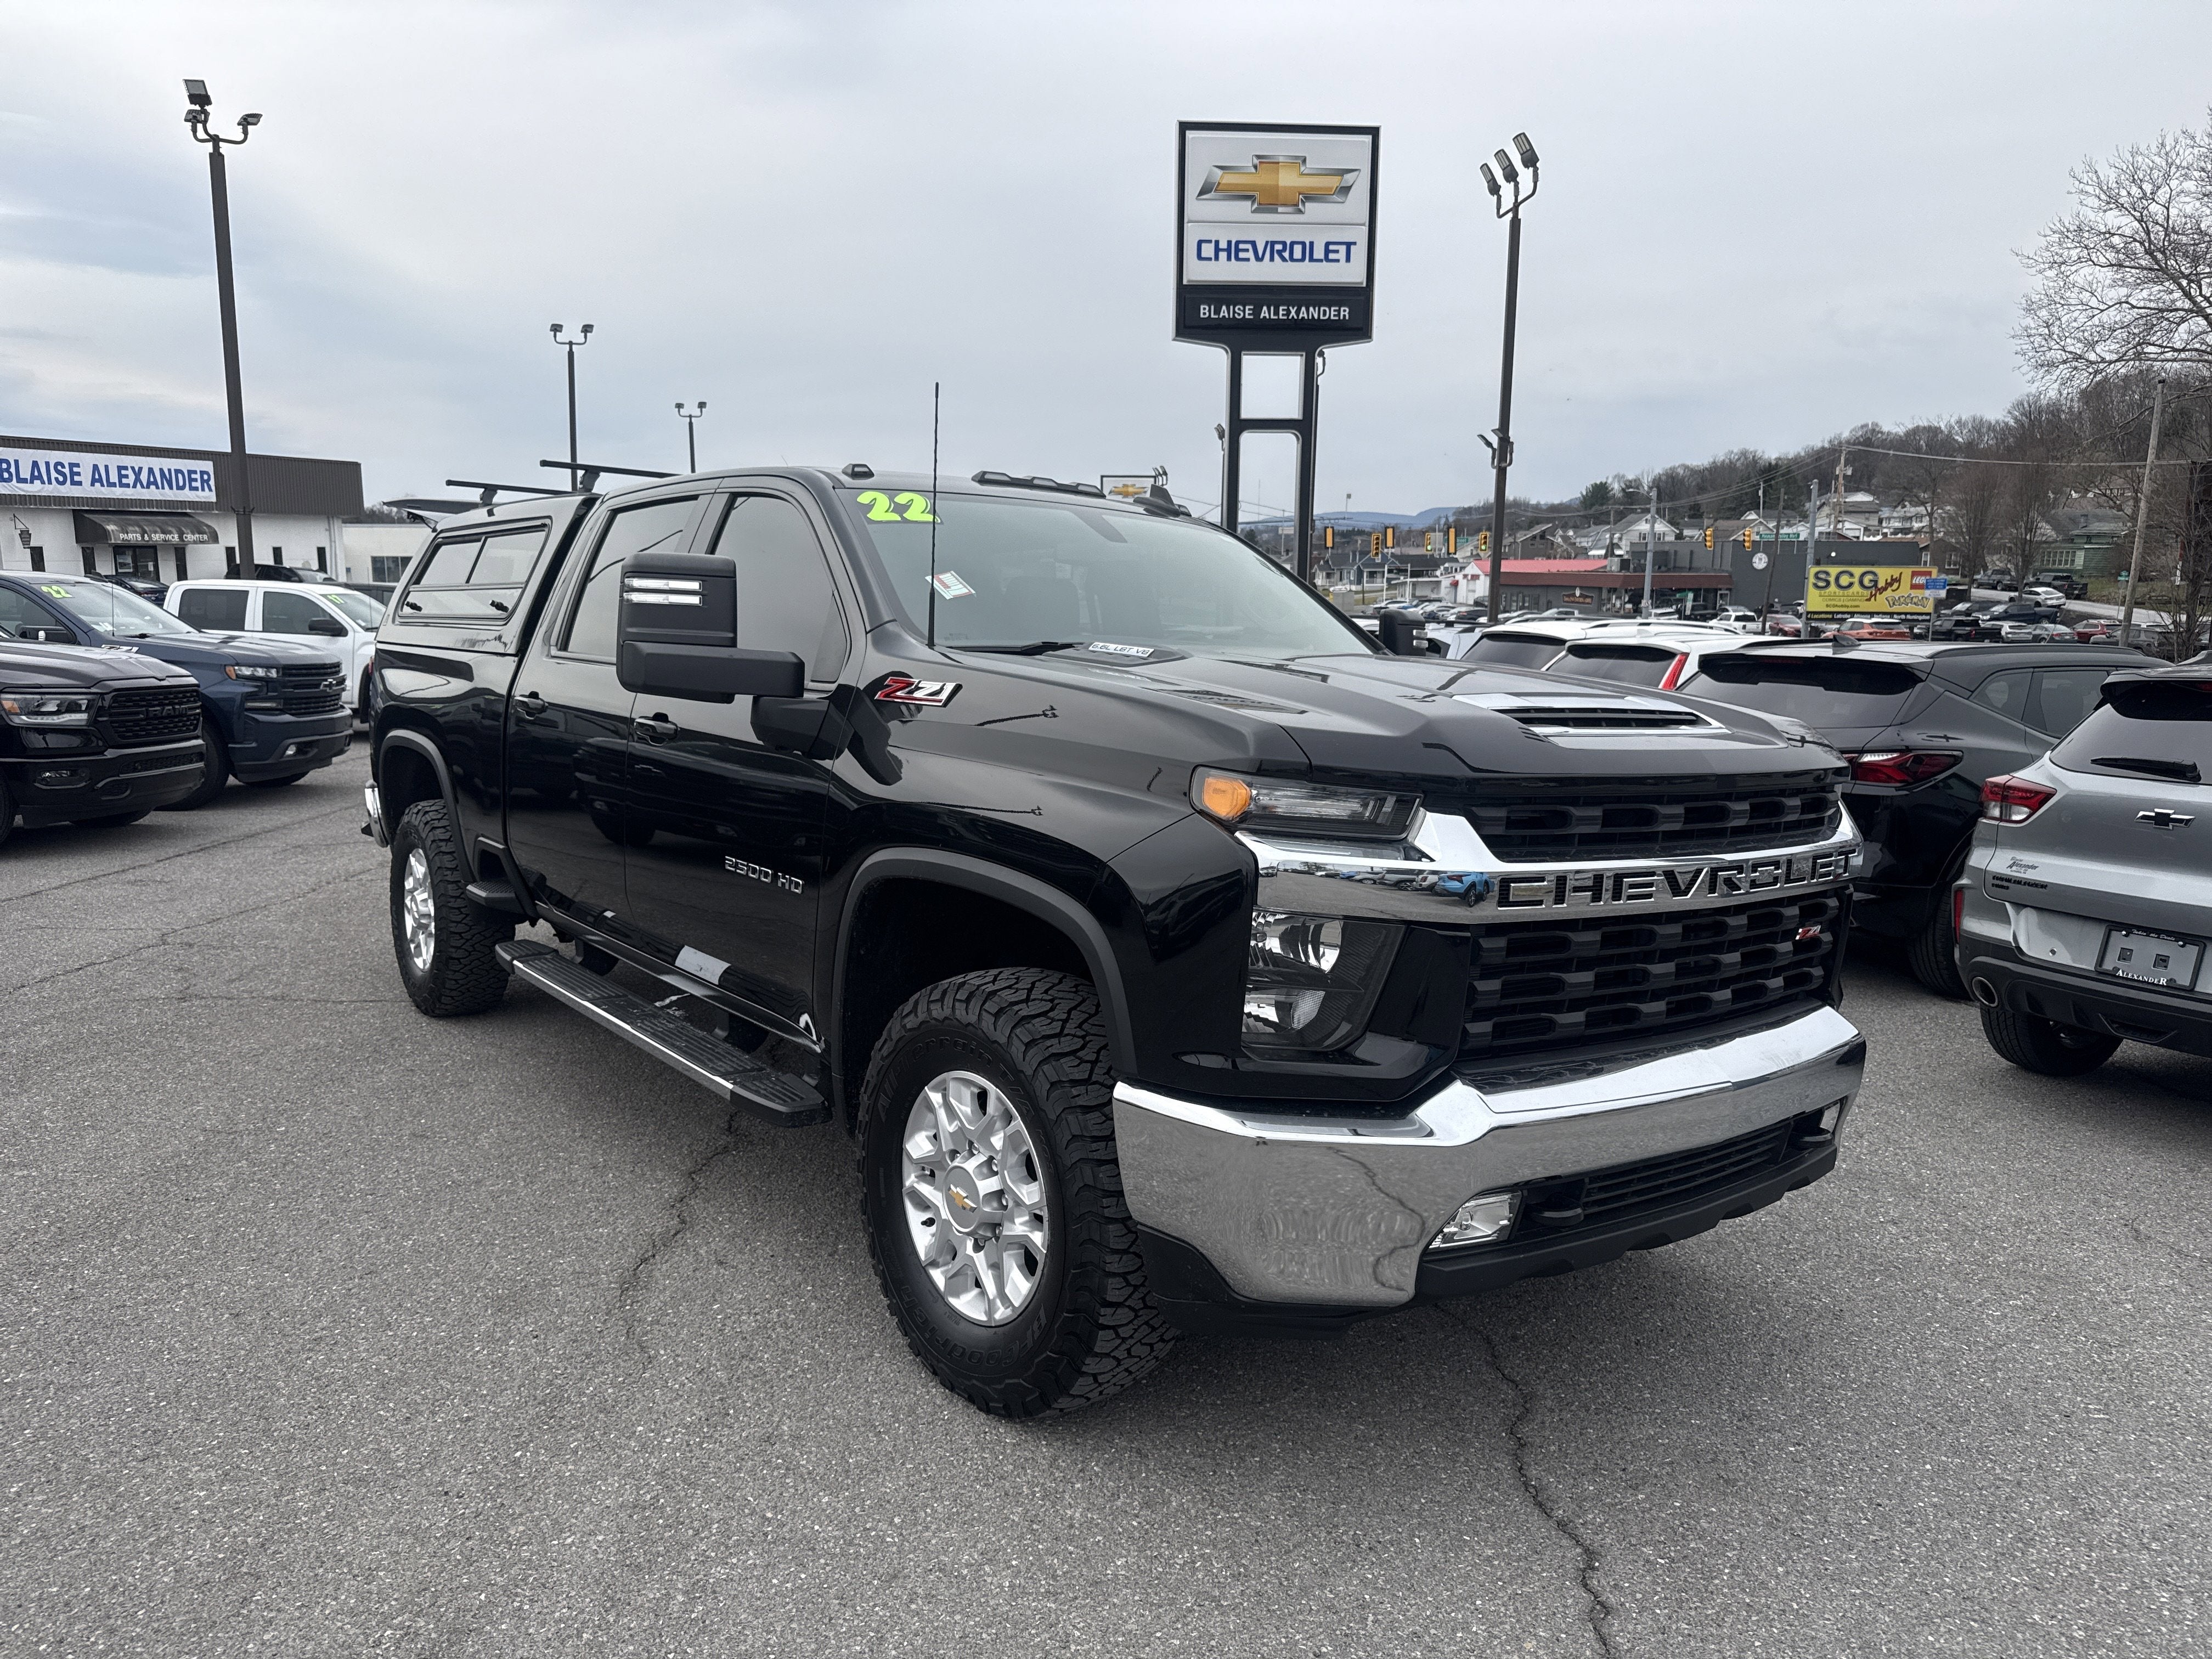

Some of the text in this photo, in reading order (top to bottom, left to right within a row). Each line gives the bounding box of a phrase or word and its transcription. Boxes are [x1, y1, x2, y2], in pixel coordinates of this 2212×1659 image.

[1197, 239, 1357, 263] CHEVROLET
[1200, 304, 1350, 320] BLAISE ALEXANDER
[0, 458, 213, 492] BLAISE ALEXANDER
[856, 491, 940, 523] 22
[1812, 569, 1903, 601] SCG Hobby
[874, 676, 961, 707] Z71
[725, 855, 804, 894] 2500 HD
[1497, 848, 1859, 910] CHEVROLET
[2006, 861, 2039, 870] Alexander
